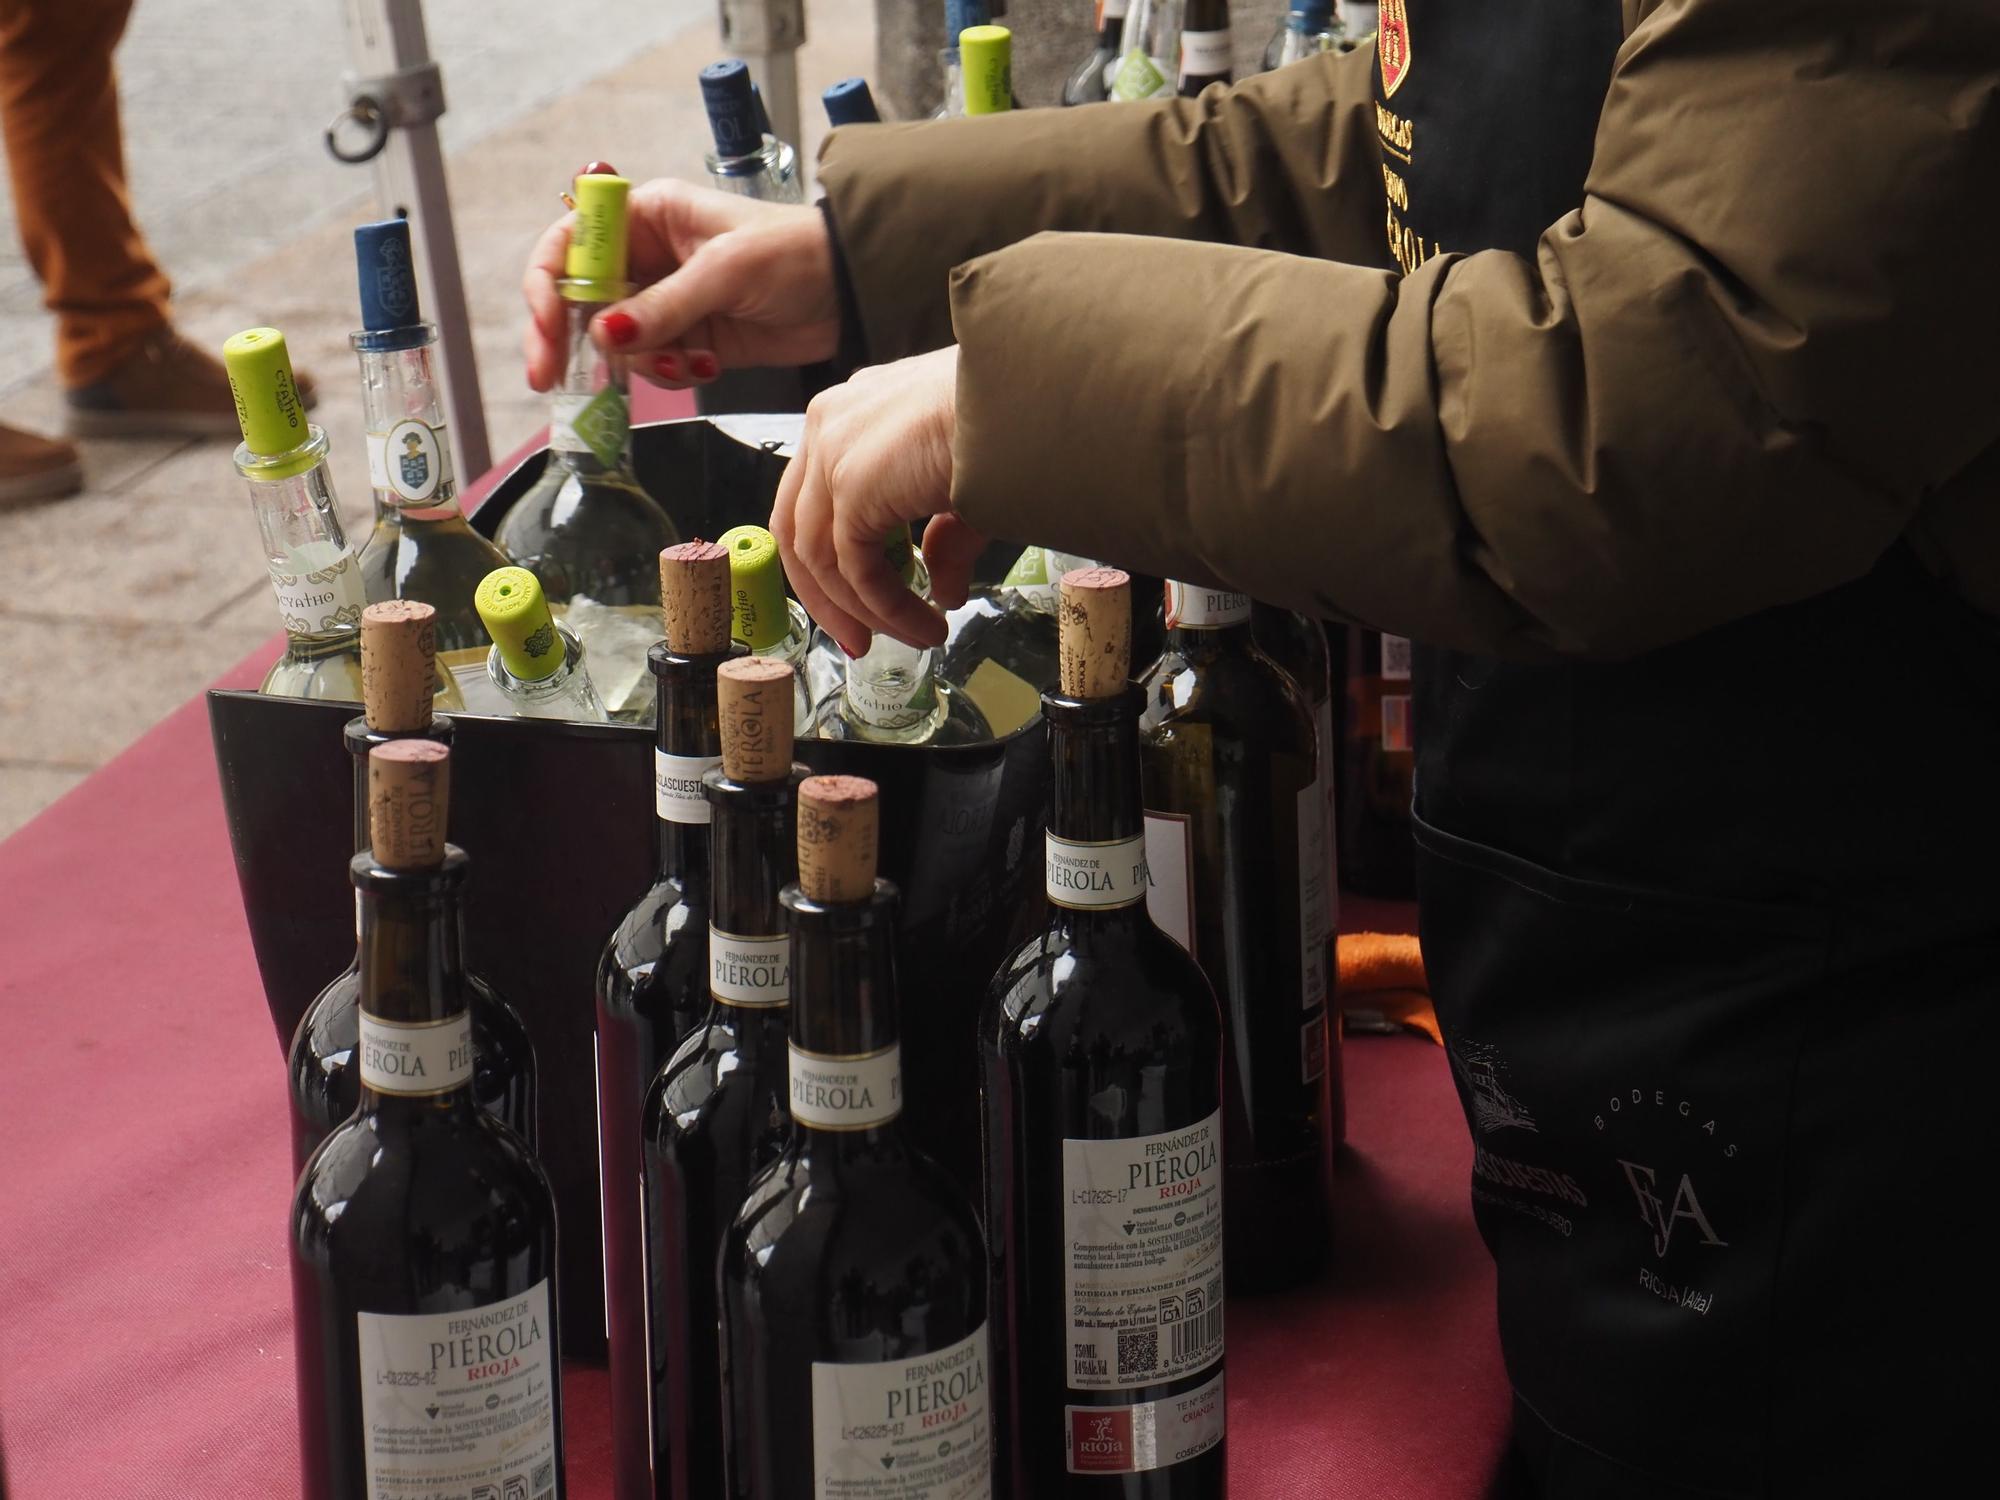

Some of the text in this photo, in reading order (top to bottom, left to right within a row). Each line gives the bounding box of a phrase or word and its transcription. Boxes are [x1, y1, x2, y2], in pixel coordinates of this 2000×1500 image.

[1090, 859, 1100, 869] DE
[769, 954, 780, 964] DE
[793, 1077, 875, 1110] PIÉROLA
[1593, 1087, 1739, 1159] BODEGAS
[1145, 1130, 1201, 1157] FERNÁNDEZ
[1128, 1141, 1217, 1190] PIÉROLA
[1159, 1178, 1202, 1199] RIOJA
[517, 1300, 529, 1317] DE
[430, 1315, 541, 1371] PIÉROLA
[468, 1356, 521, 1381] RIOJA
[887, 1359, 985, 1419] PIÉROLA
[922, 1402, 968, 1429] RIOJA
[1175, 1442, 1208, 1460] COSECHA
